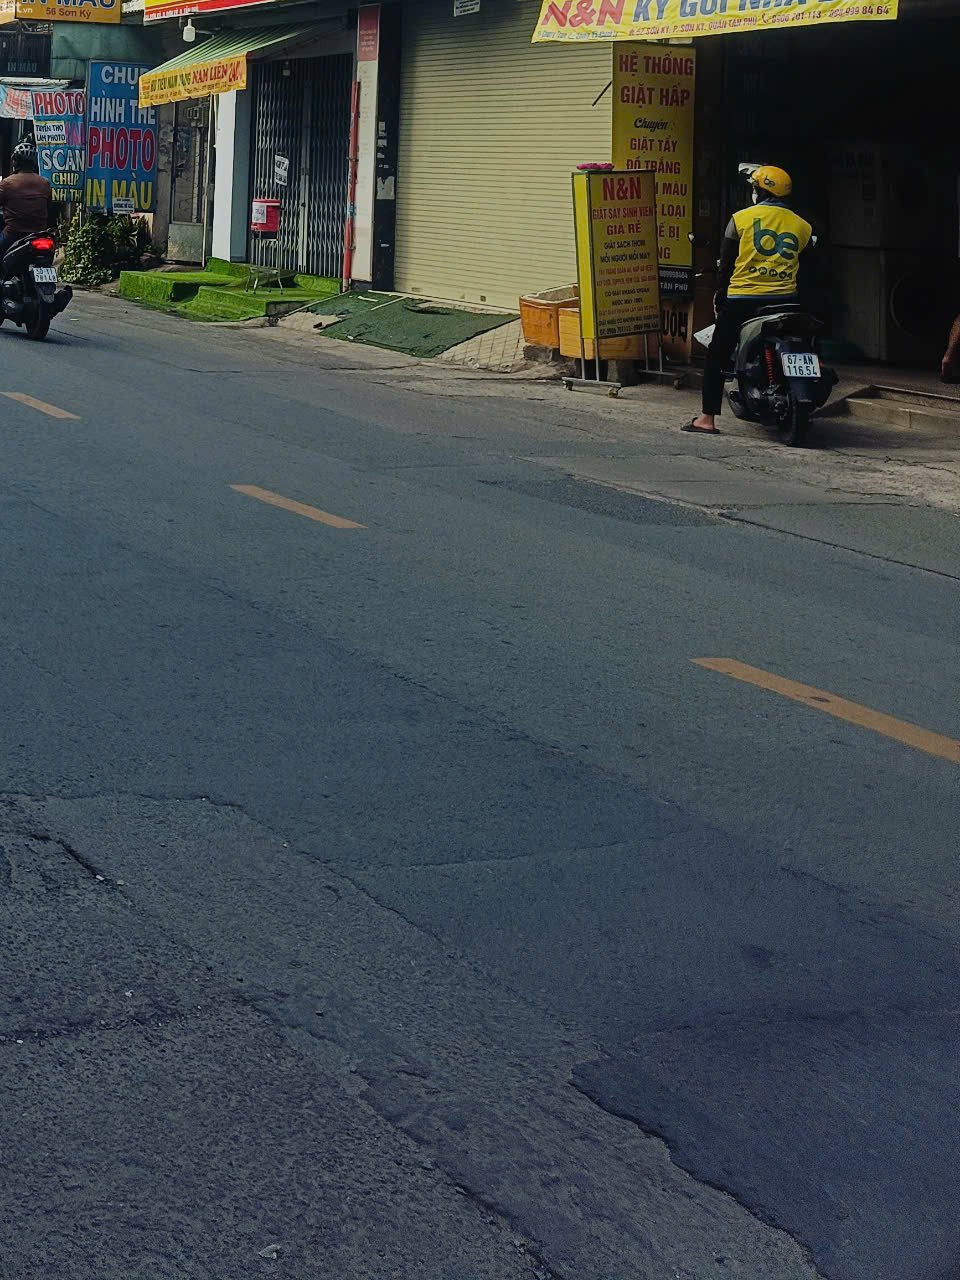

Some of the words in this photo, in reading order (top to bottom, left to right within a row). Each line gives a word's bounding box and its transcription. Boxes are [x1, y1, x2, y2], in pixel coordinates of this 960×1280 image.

[46, 7, 57, 16] 56
[58, 7, 77, 17] Sơn
[79, 8, 91, 19] Kỳ
[861, 6, 874, 15] 84
[876, 6, 890, 15] 64
[619, 51, 639, 76] HỆ
[643, 50, 694, 76] THỐNG
[192, 68, 209, 85] NAM
[209, 62, 228, 81] LIÊN
[33, 91, 86, 116] PHOTO
[620, 83, 655, 108] GIẶT
[660, 82, 690, 107] HẤP
[91, 91, 125, 124] HÌNH
[47, 133, 66, 142] PHOTO
[630, 136, 655, 154] GIẶT
[658, 135, 678, 153] TẨY
[88, 127, 156, 171] PHOTO
[41, 149, 85, 171] SCAN
[645, 158, 681, 174] TRẮNG
[602, 176, 642, 201] N&N
[662, 181, 688, 197] MÀU
[764, 175, 776, 187] be
[86, 178, 105, 208] IN
[112, 172, 153, 210] MÀU
[661, 204, 686, 220] LOẠI
[607, 221, 625, 236] GIÁ
[628, 220, 642, 234] RẺ
[669, 226, 680, 242] BỊ
[753, 218, 799, 260] be
[787, 355, 814, 366] 67-AN
[787, 365, 818, 376] 116.54
